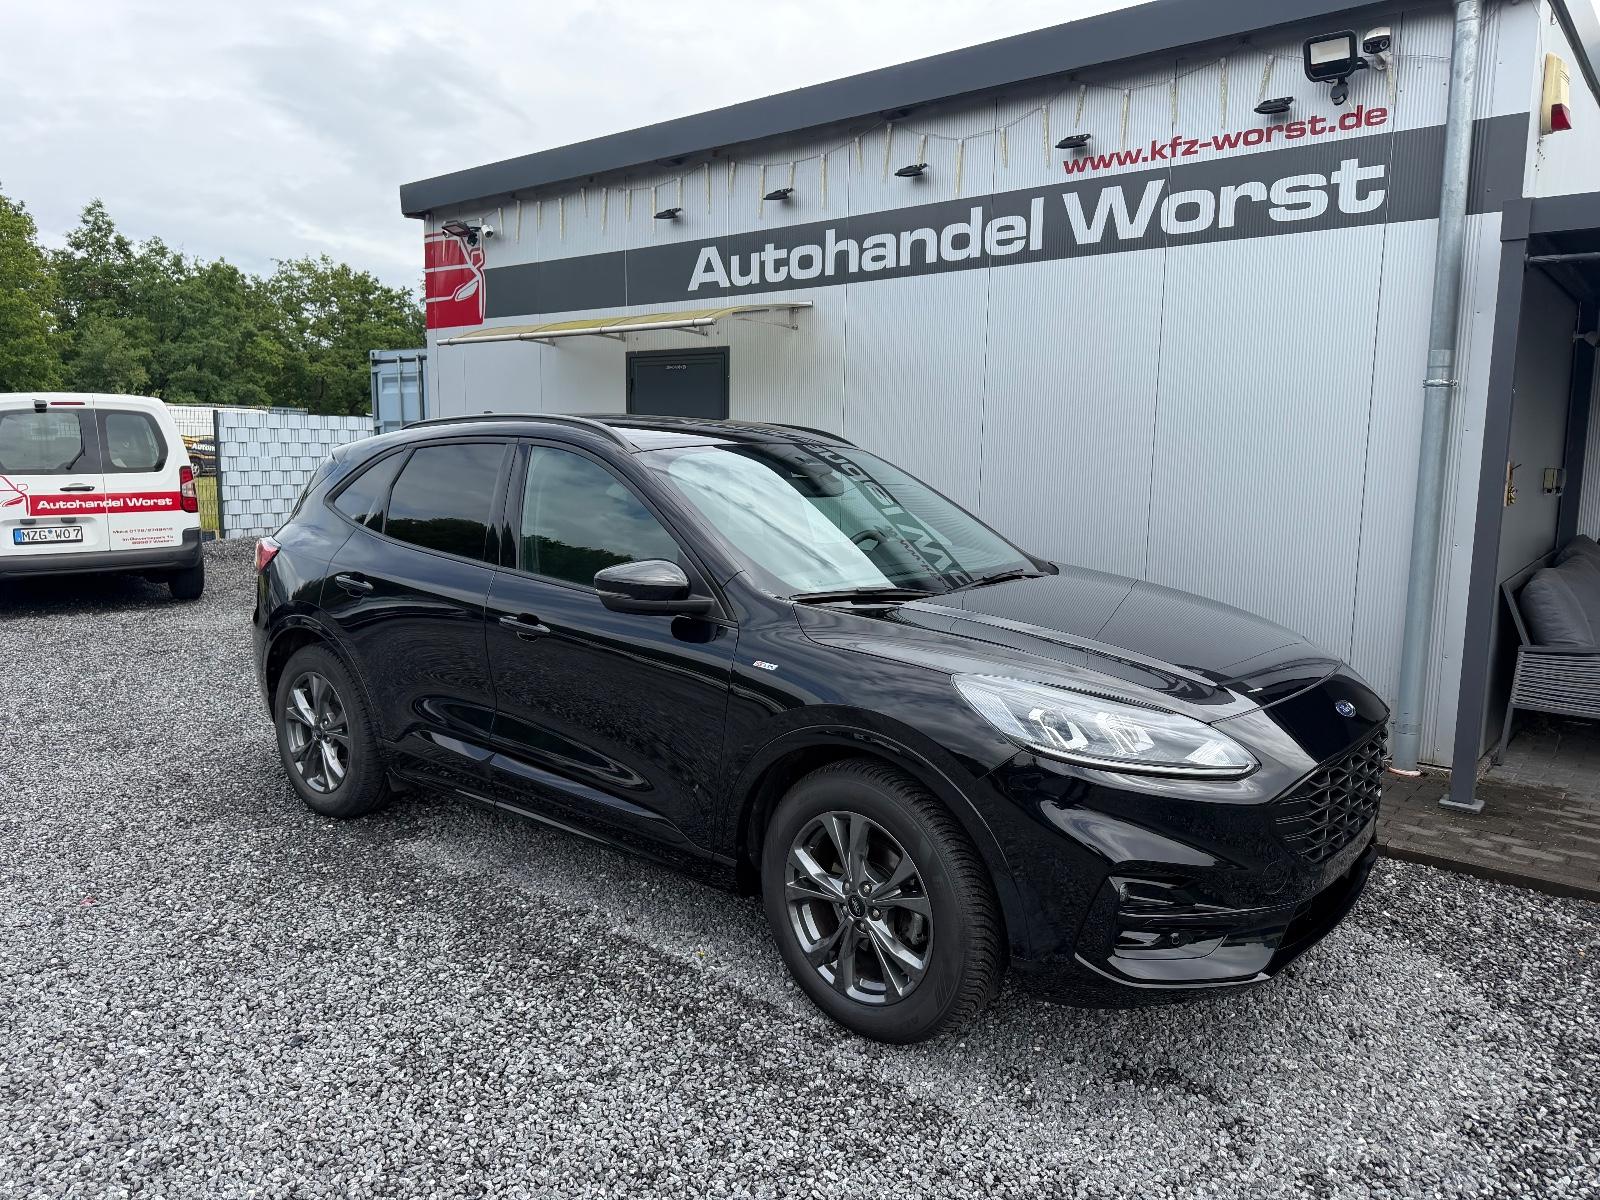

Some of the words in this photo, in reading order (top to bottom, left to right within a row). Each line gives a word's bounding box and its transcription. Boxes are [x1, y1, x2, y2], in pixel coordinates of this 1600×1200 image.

[1064, 105, 1388, 174] www.kfz-worst.de
[687, 196, 1044, 292] Autohandel
[1063, 157, 1387, 246] Worst
[37, 497, 123, 510] Autohandel
[125, 497, 173, 507] Worst
